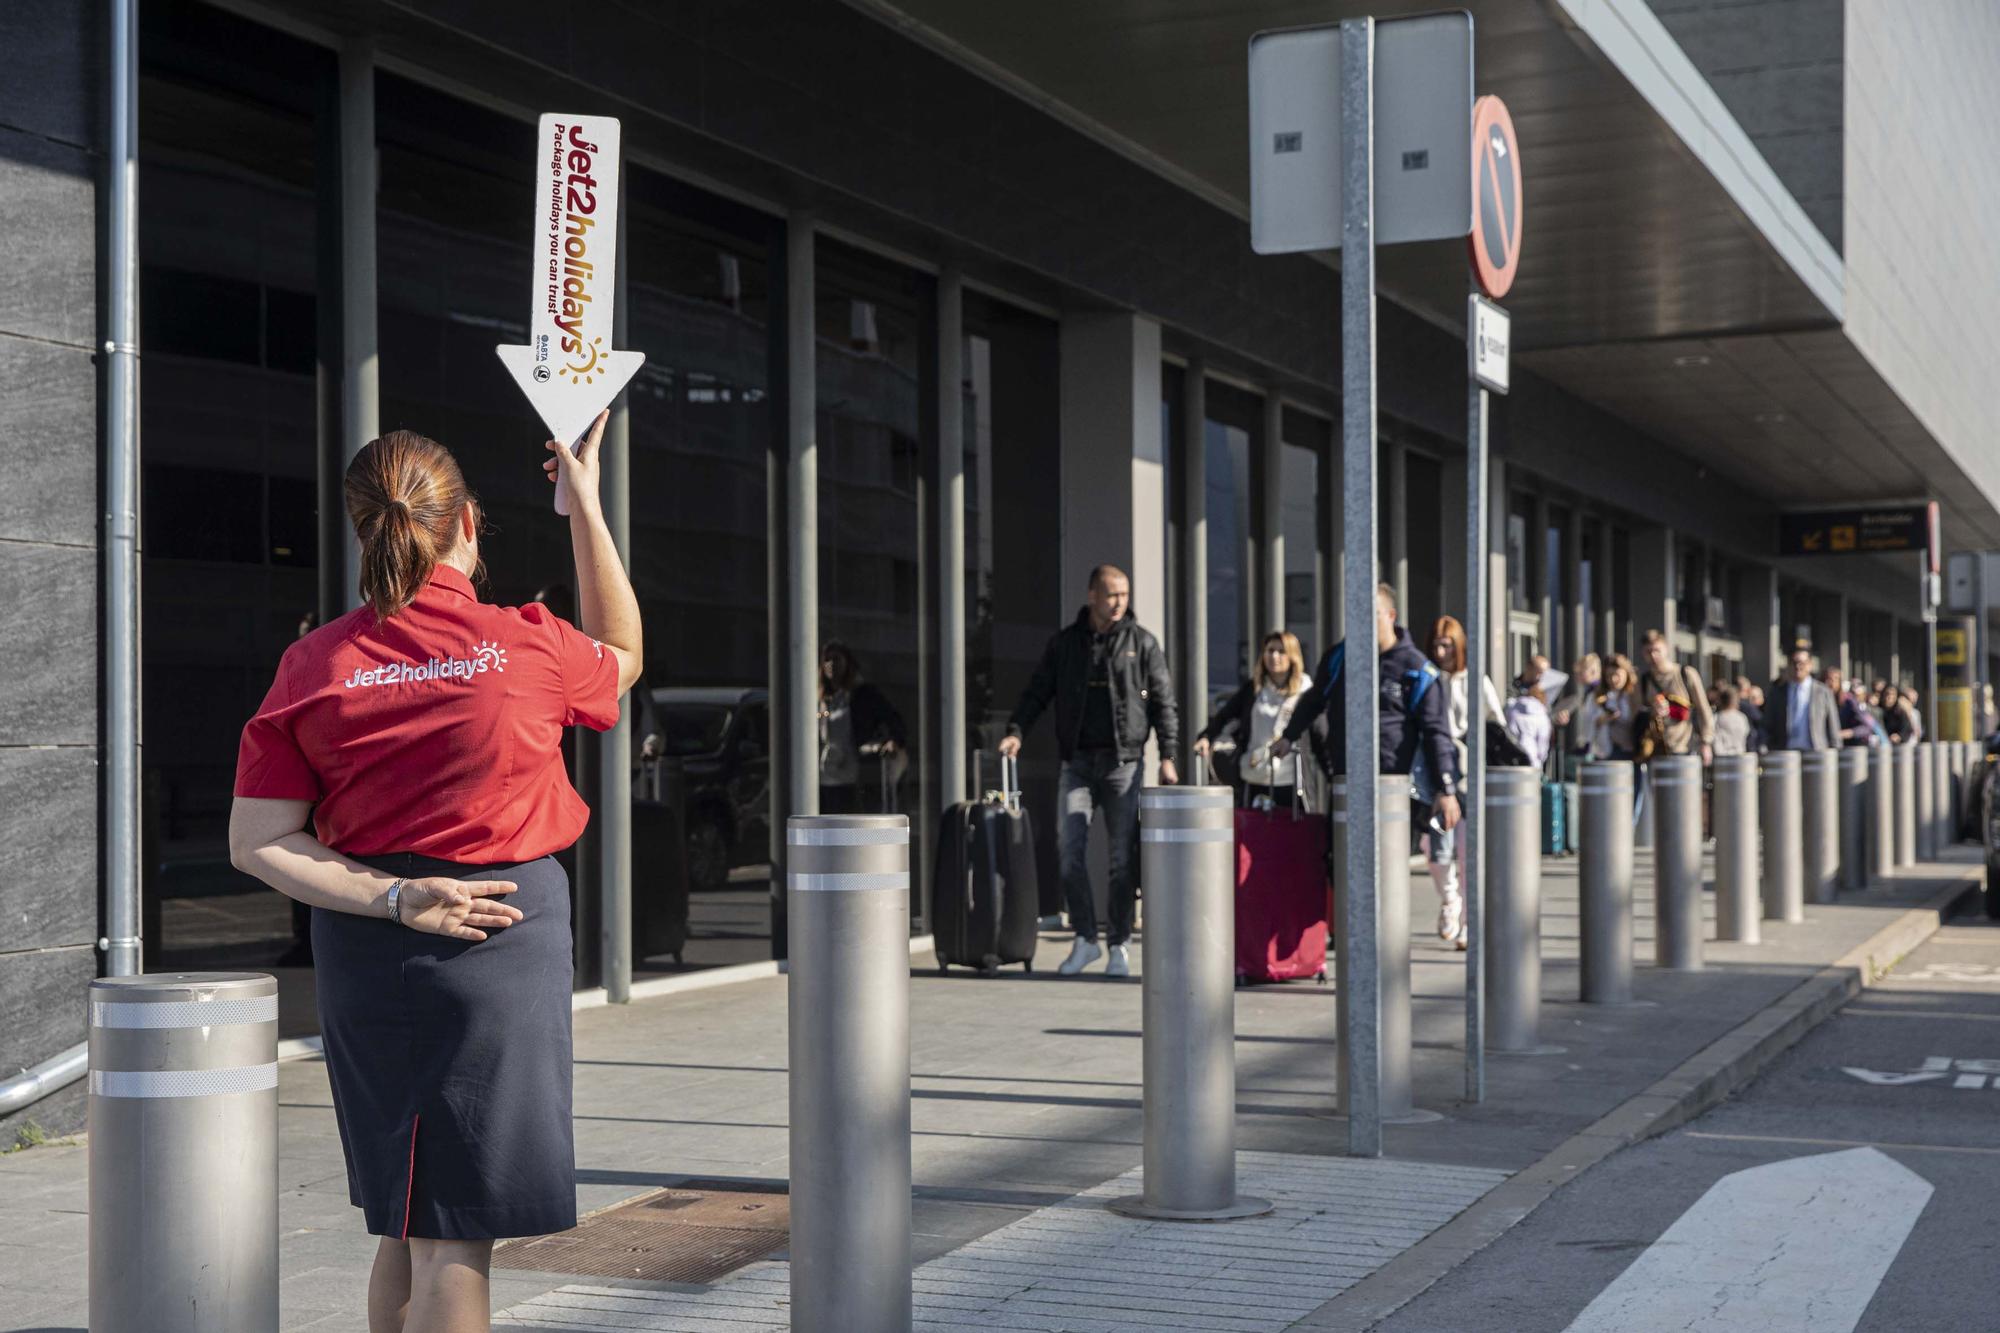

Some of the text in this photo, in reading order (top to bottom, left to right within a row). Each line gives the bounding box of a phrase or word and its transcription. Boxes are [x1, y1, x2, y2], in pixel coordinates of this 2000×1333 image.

[548, 123, 565, 314] Package holidays you can trust
[554, 125, 598, 355] Jet2holidays
[345, 656, 489, 688] Jet2holidays
